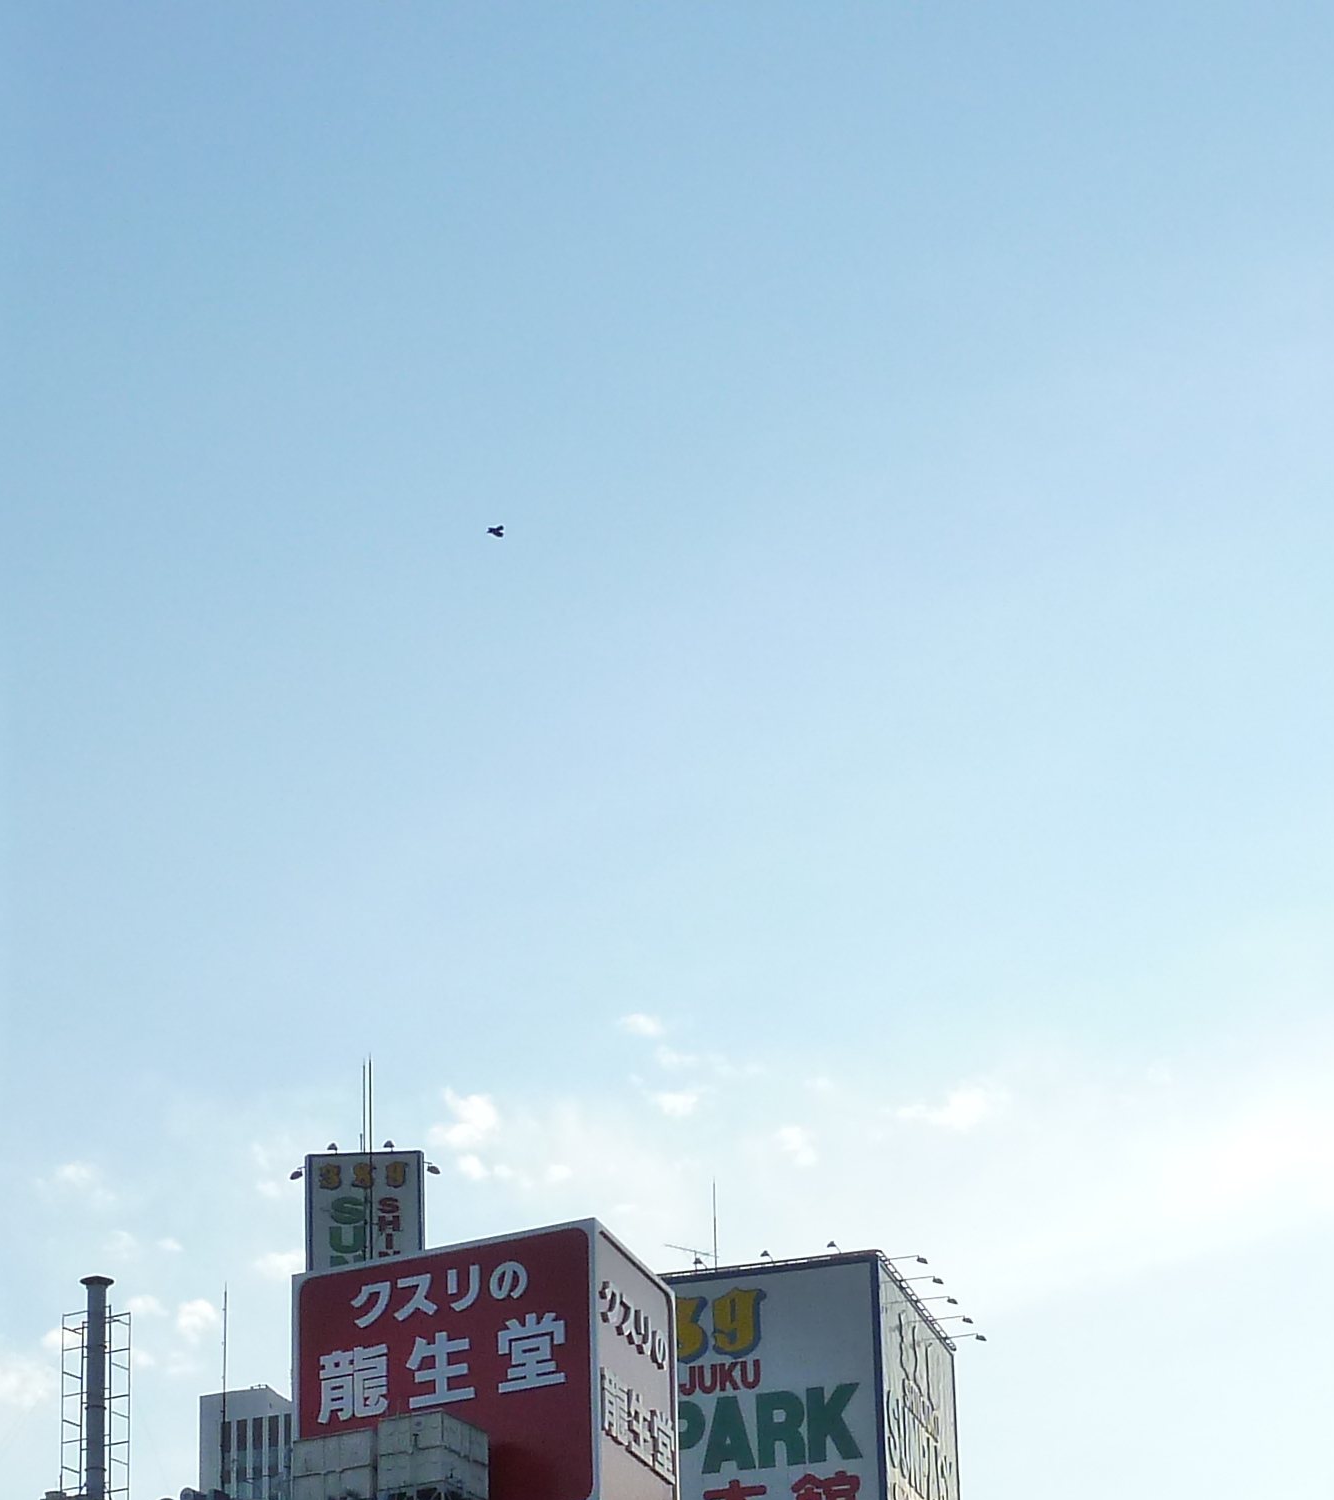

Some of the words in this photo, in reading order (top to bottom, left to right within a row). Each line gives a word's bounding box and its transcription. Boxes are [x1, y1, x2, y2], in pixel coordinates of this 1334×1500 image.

[350, 1260, 529, 1329] クスリの
[318, 1312, 567, 1425] 龍生堂
